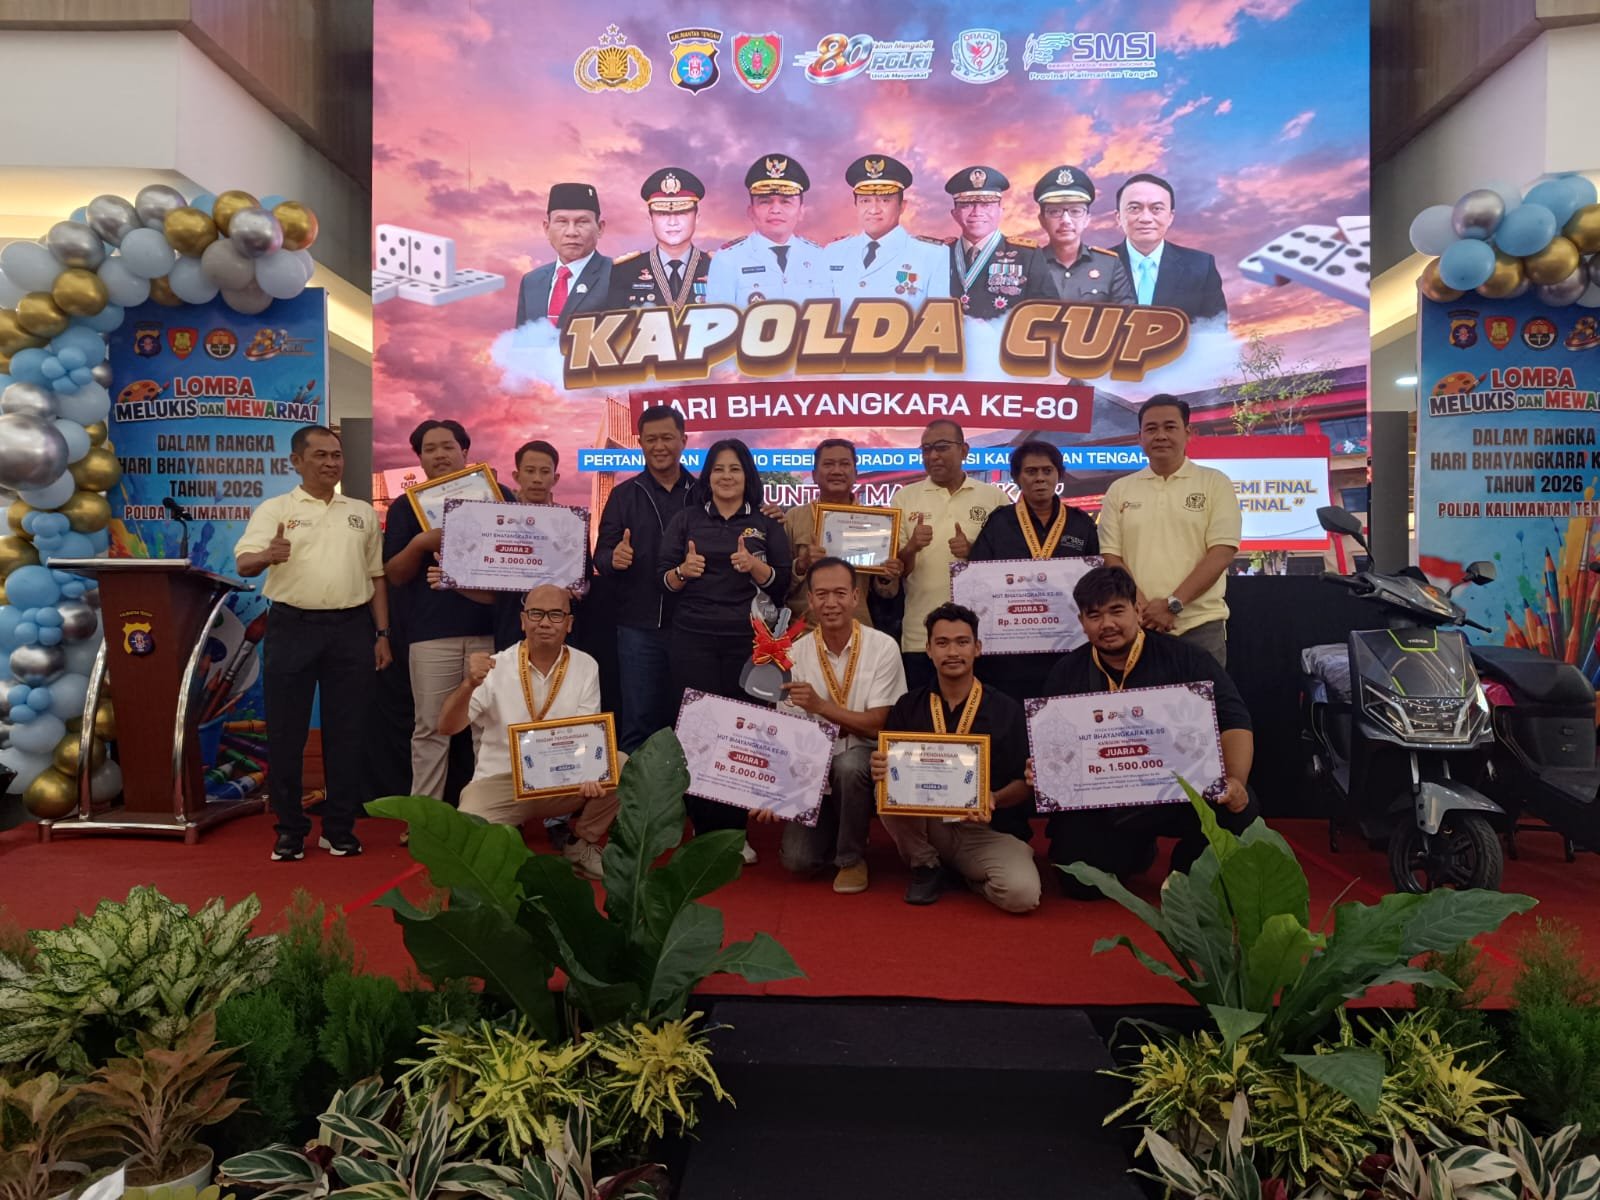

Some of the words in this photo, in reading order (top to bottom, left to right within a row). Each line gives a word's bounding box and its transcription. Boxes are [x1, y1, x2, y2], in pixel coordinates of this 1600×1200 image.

[963, 33, 996, 41] ORADO
[1073, 34, 1155, 60] SMSI
[871, 51, 932, 70] POLRI
[1069, 71, 1122, 79] Kalimantan
[1124, 70, 1157, 80] Tengah
[562, 298, 963, 380] KAPOLDA
[1003, 300, 1188, 372] CUP
[175, 376, 256, 398] LOMBA
[1491, 367, 1576, 390] LOMBA
[115, 399, 199, 422] MELUKIS
[200, 403, 224, 415] DAN
[225, 398, 318, 423] MEWARNAI
[728, 393, 970, 418] BHAYANGKARA
[981, 394, 1078, 420] KE-80
[1429, 390, 1516, 416] MELUKIS
[1517, 394, 1543, 408] DAN
[158, 435, 210, 452] DALAM
[216, 435, 275, 452] RANGKA
[1473, 428, 1528, 446] DALAM
[1534, 428, 1596, 446] RANGKA
[118, 458, 151, 474] HARI
[157, 457, 265, 475] BHAYANGKARA
[271, 458, 295, 475] KE-
[1087, 452, 1150, 464] TENGAH
[1431, 452, 1467, 471] HARI
[1472, 451, 1586, 470] BHAYANGKARA
[170, 480, 217, 497] TAHUN
[223, 480, 263, 497] 2026
[1232, 481, 1261, 494] EMI
[1264, 480, 1318, 494] FINAL
[1485, 476, 1535, 493] TAHUN
[1541, 475, 1583, 493] 2026
[125, 505, 165, 520] POLDA
[1239, 498, 1291, 512] FINAL
[1439, 502, 1480, 517] POLDA
[1486, 502, 1571, 517] KALIMANTAN
[500, 556, 543, 566] 3.000.000
[998, 618, 1012, 627] Rp.
[1013, 616, 1060, 625] 2.000.000
[734, 753, 760, 766] JUARA
[1105, 748, 1136, 757] JUARA
[1136, 746, 1144, 754] 4
[714, 761, 728, 772] Rp.
[729, 765, 776, 784] 5.000.000
[1088, 764, 1106, 774] Rp.
[1109, 759, 1164, 772] 1.500.000
